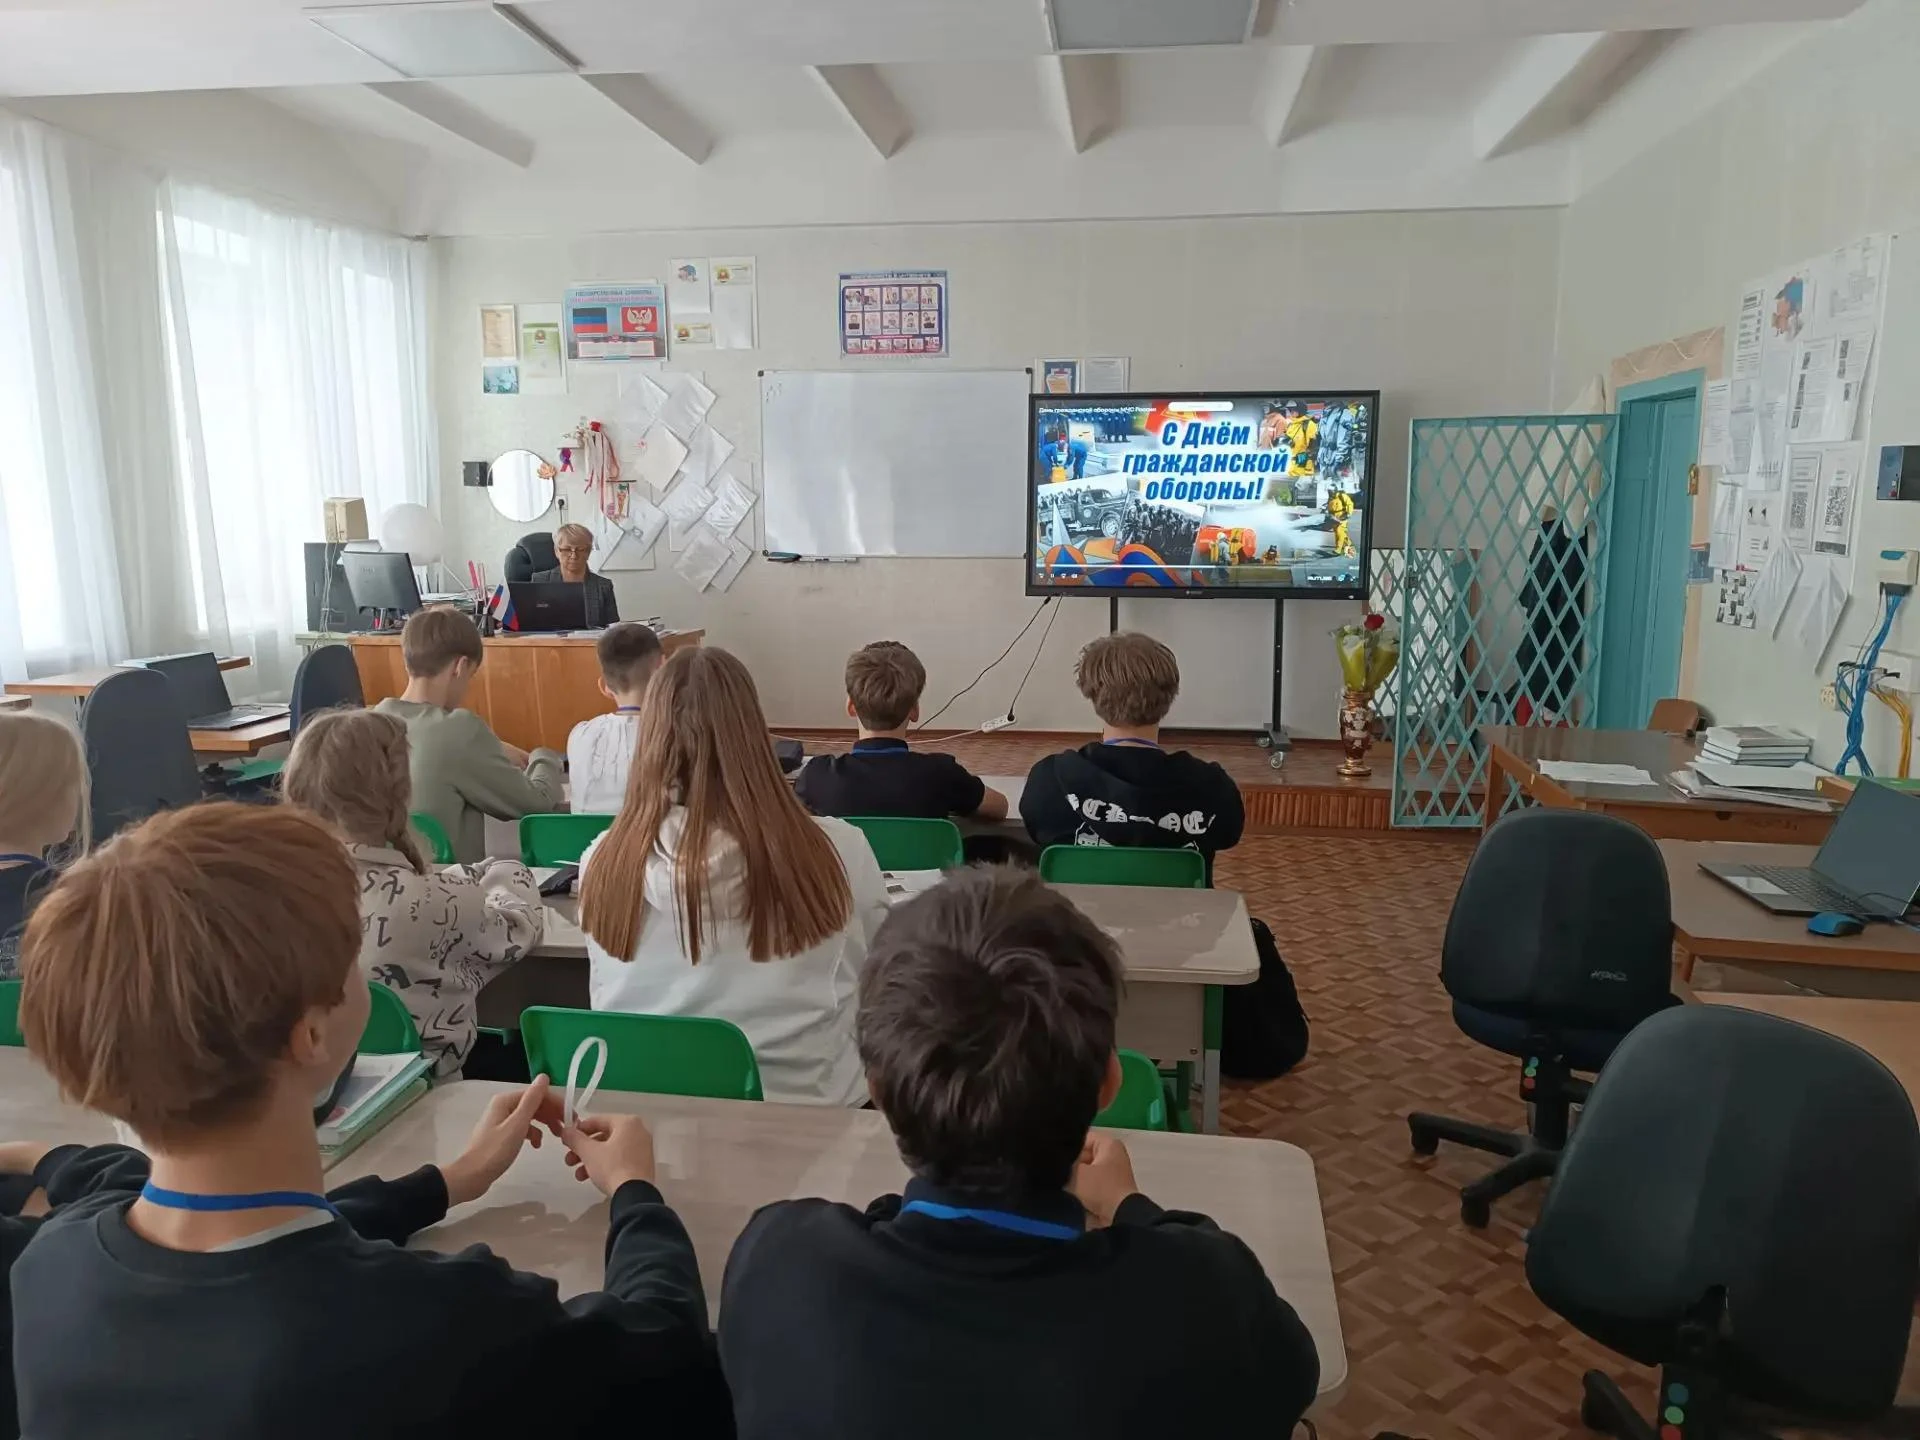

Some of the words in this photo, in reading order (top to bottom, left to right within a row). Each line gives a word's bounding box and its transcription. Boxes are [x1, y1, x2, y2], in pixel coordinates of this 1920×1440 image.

[1162, 422, 1178, 446] С
[1182, 421, 1250, 448] Днём
[1122, 449, 1289, 476] гражданской
[1145, 477, 1264, 502] обороны!
